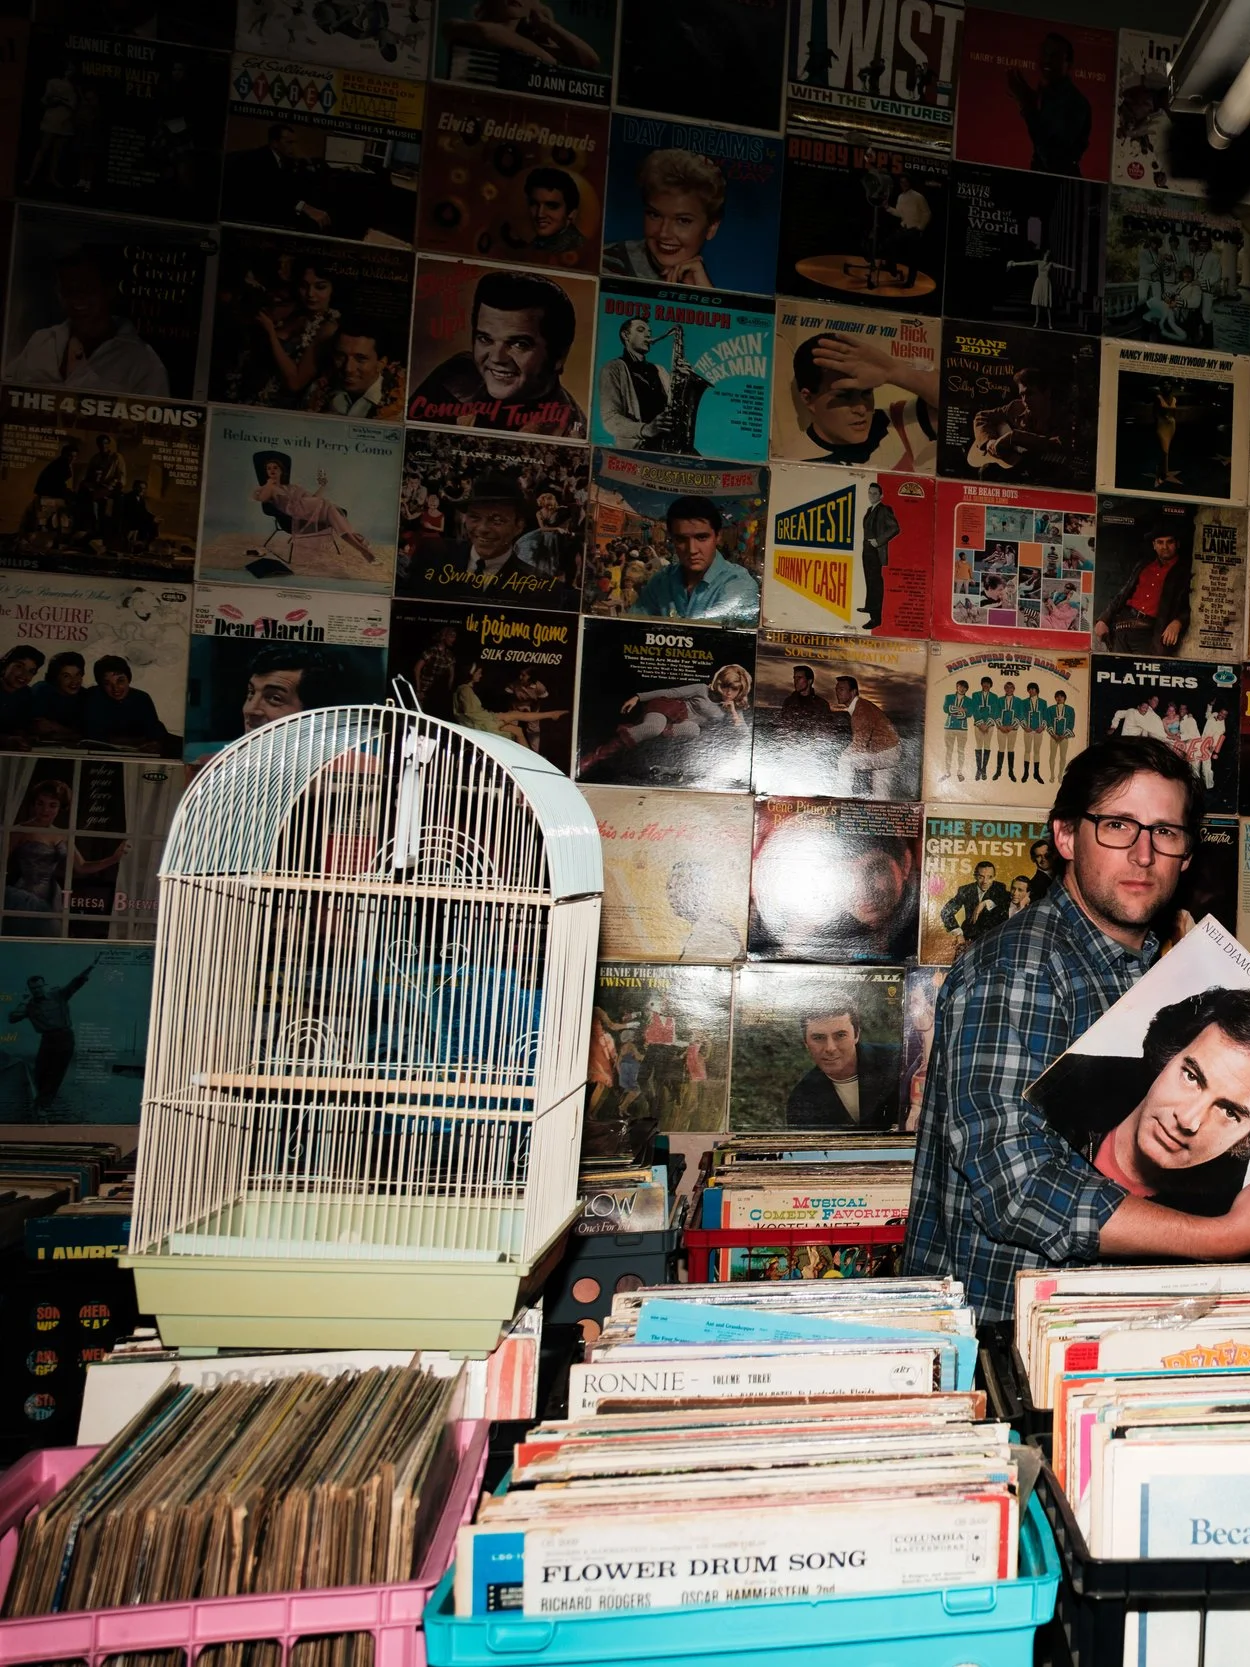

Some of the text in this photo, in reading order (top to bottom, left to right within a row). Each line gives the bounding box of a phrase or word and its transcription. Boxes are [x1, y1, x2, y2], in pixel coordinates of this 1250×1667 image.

[126, 43, 156, 62] RILEY
[528, 73, 605, 98] JO ANN CASTLE
[792, 85, 950, 122] WITH THE VENTURES
[622, 117, 765, 162] DAY DREAMS
[968, 216, 1020, 236] World
[658, 290, 722, 304] STEREO
[604, 298, 732, 329] BOOTS RANDOLPH
[782, 314, 897, 338] THE VERY THOUGHT OF YOU
[900, 324, 928, 343] Rick
[891, 340, 934, 361] Nelson
[956, 335, 1008, 351] DUANE
[960, 343, 1001, 357] EDDY
[8, 390, 55, 411] THE
[60, 395, 76, 413] 4
[409, 398, 571, 427] Conway Twitty
[223, 428, 393, 457] Relaxing with Perry Como
[963, 485, 1019, 499] THE BEACH BOYS
[777, 492, 853, 543] GREATEST!
[1203, 527, 1237, 542] FRANKIE
[1203, 539, 1237, 556] LAINE
[425, 568, 434, 581] a
[501, 574, 558, 592] Affair!
[776, 556, 812, 590] JOHNNY
[813, 560, 846, 609] CASH
[16, 605, 94, 623] McGUIRE
[17, 622, 89, 641] SISTERS
[214, 619, 255, 638] Dean
[261, 620, 325, 641] Martin
[466, 613, 568, 647] the pajama game
[645, 634, 694, 647] BOOTS
[481, 648, 562, 664] SILK STOCKINGS
[623, 645, 713, 660] NANCY SINATRA
[988, 662, 1031, 671] GREATEST
[1134, 663, 1161, 672] THE
[1097, 671, 1198, 688] PLATTERS
[928, 819, 963, 836] THE
[972, 821, 1022, 838] FOUR
[927, 839, 1025, 857] GREATEST
[926, 857, 972, 874] HITS
[1202, 922, 1226, 946] NEIL
[793, 1197, 867, 1208] MUSICAL
[750, 1208, 908, 1220] COMEDY FAVORITES
[583, 1372, 684, 1394] RONNIE
[712, 1373, 771, 1385] VOLUME THREE
[893, 1531, 965, 1544] COLUMBIA
[542, 1549, 866, 1584] FLOWER DRUM SONG
[541, 1596, 592, 1612] RICHARD
[599, 1592, 651, 1608] RODGERS
[681, 1590, 719, 1605] OSCAR
